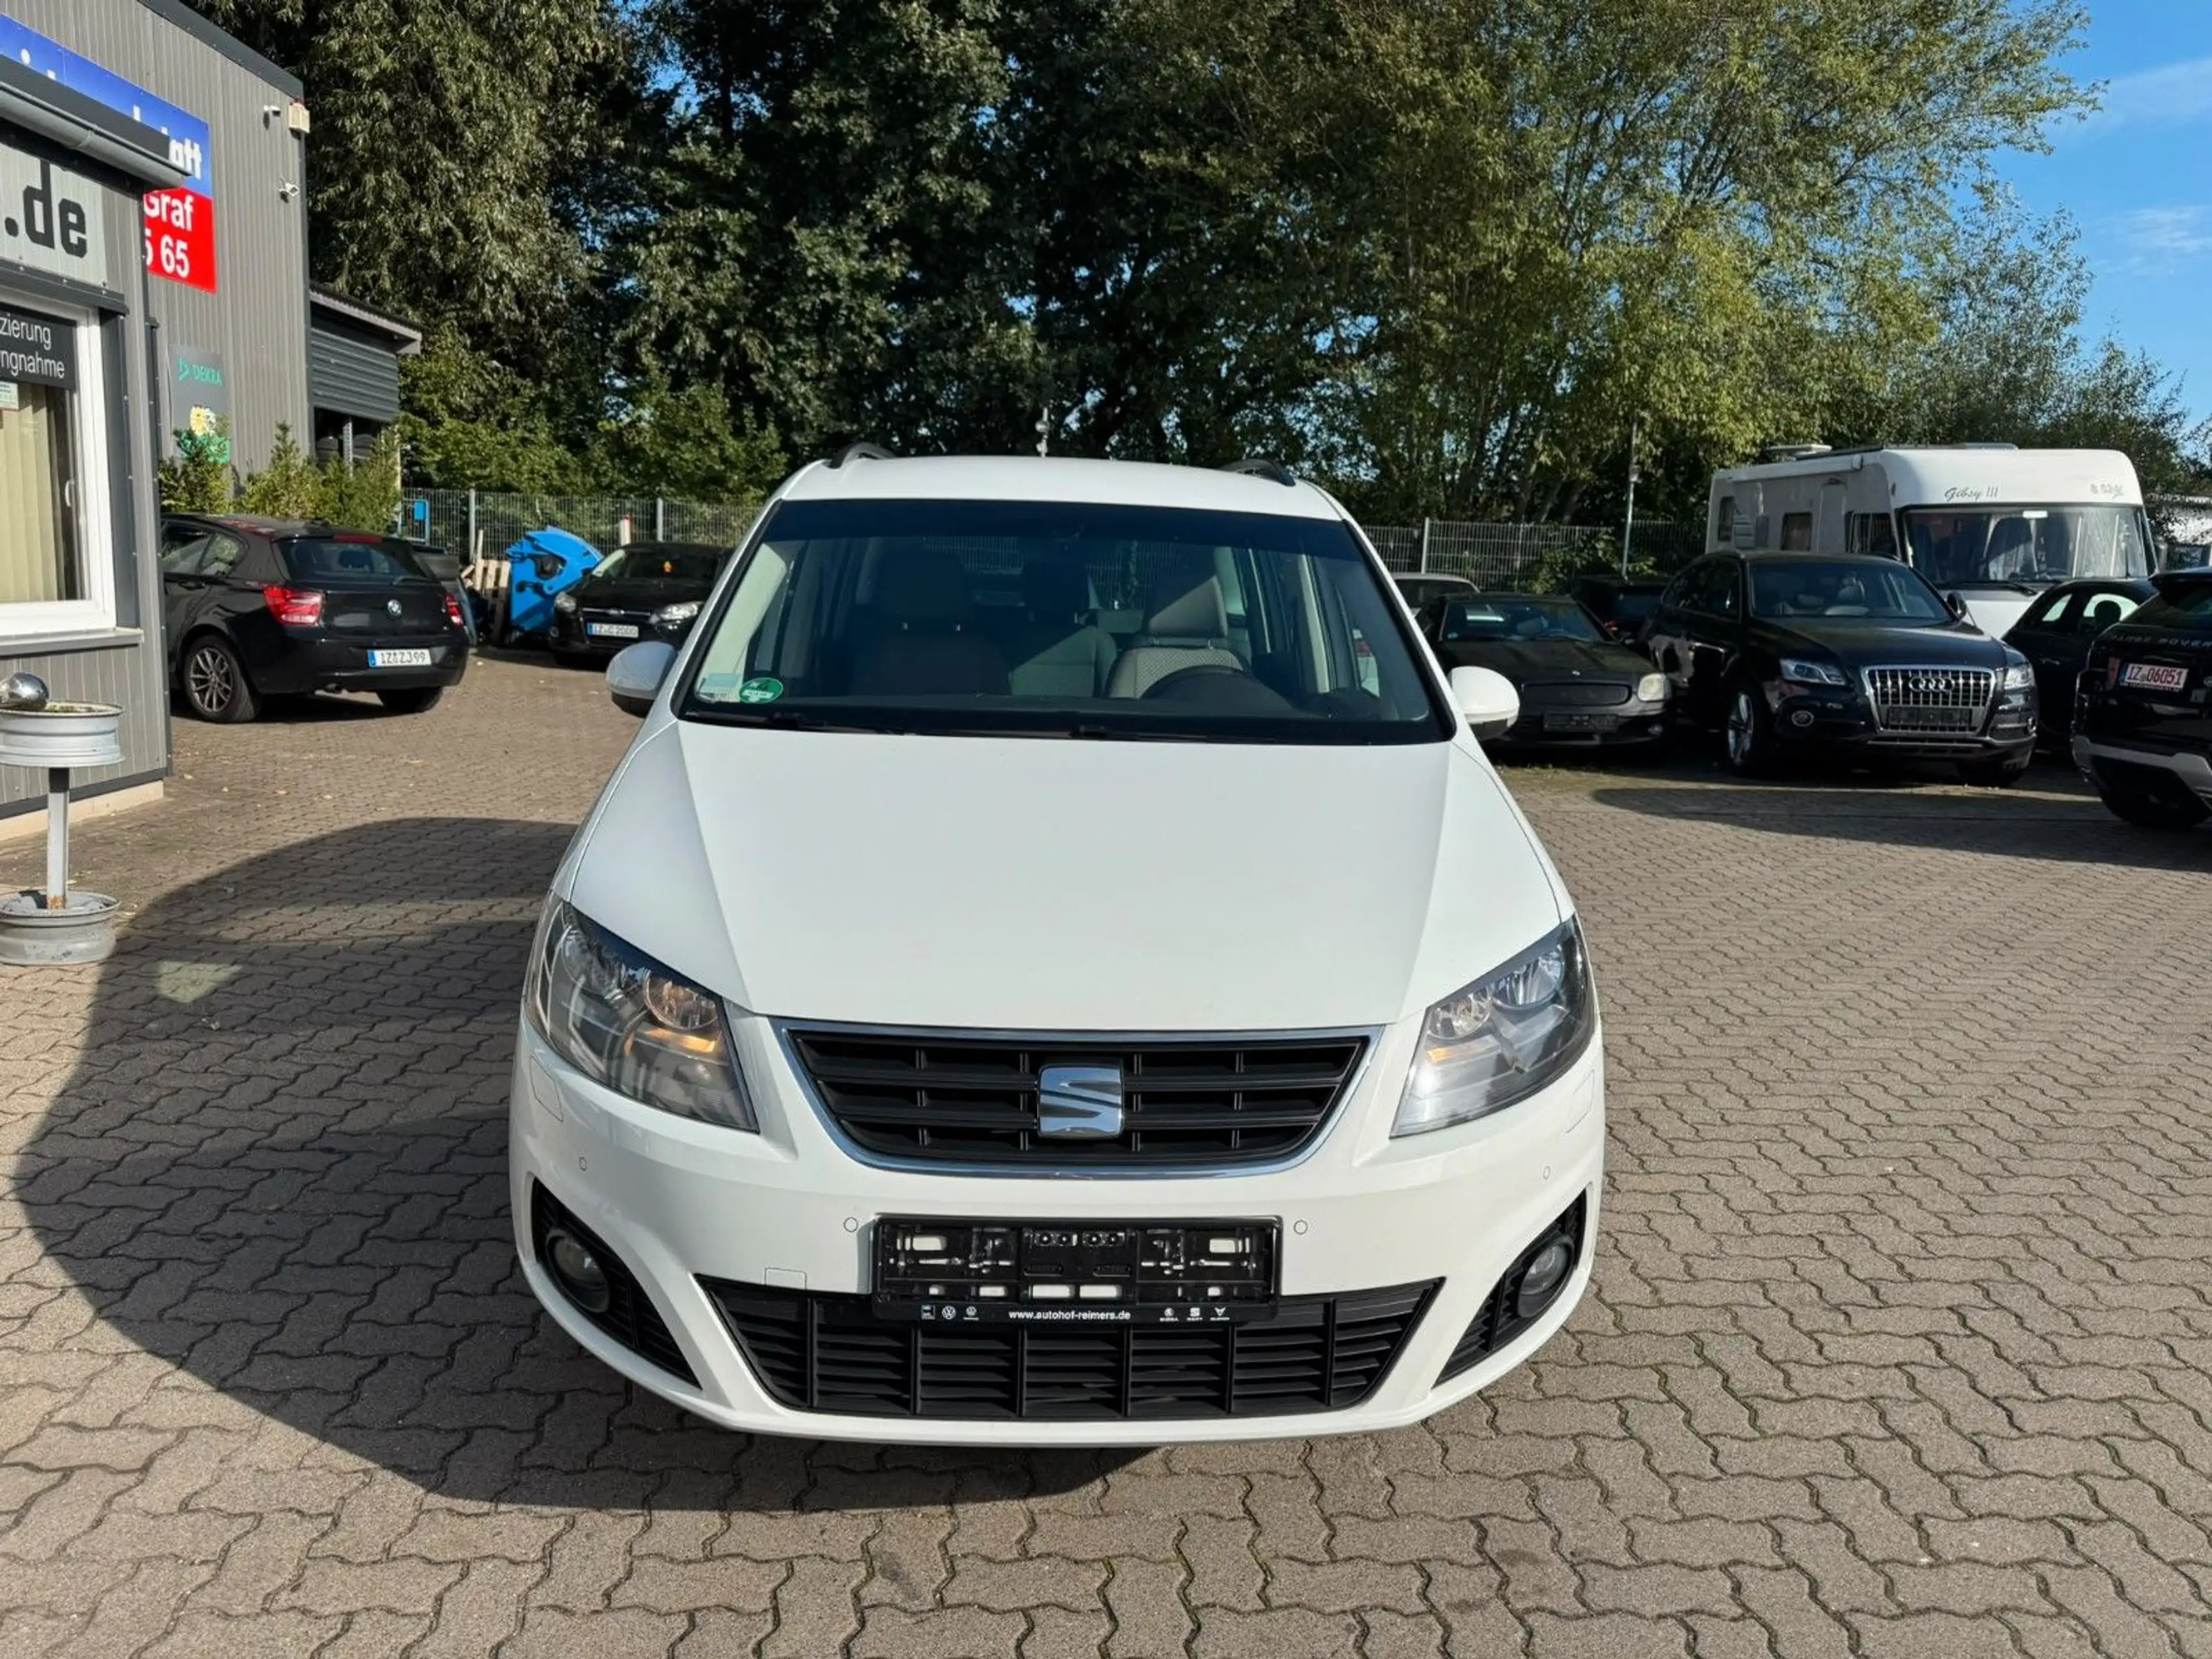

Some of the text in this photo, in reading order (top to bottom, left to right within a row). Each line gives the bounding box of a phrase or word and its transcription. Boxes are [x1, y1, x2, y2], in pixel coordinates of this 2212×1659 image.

[5, 160, 87, 258] .de
[144, 194, 193, 231] Graf
[160, 234, 190, 277] 65
[0, 314, 52, 351] zierung
[1, 351, 65, 380] ngnahme
[1008, 1309, 1131, 1320] www.autohof-reimers.de
